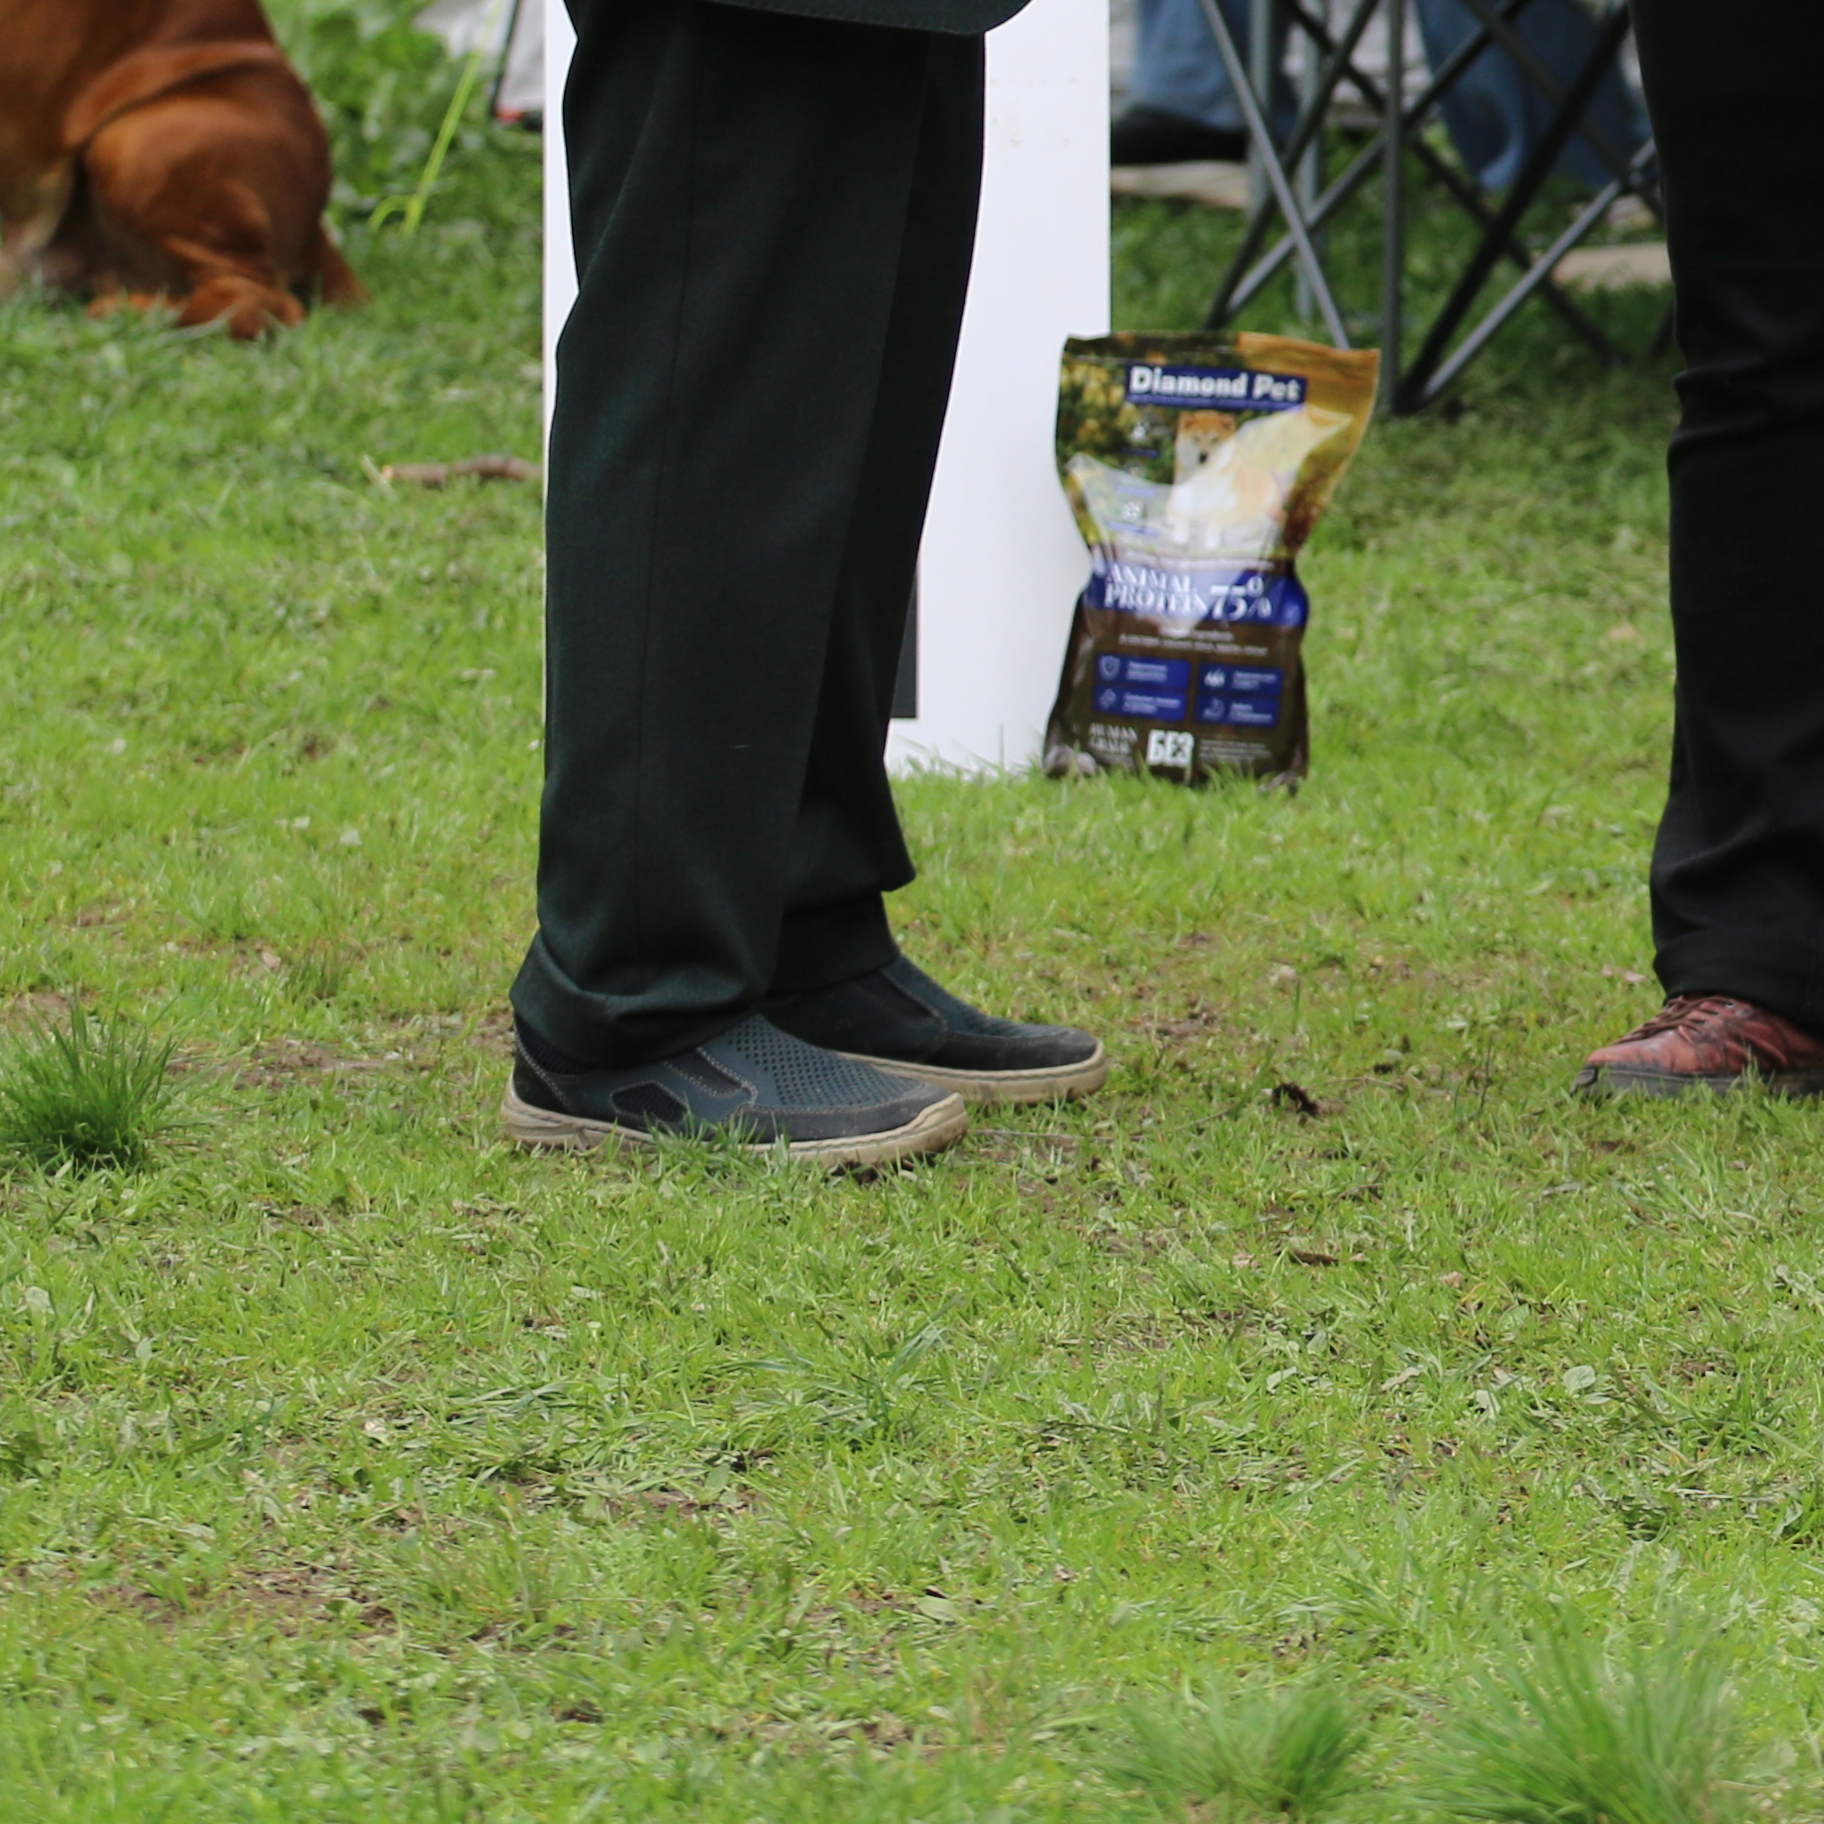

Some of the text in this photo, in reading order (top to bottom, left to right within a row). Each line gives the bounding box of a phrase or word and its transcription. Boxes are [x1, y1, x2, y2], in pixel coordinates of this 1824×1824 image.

[1129, 365, 1301, 402] Diamond Pet
[1107, 563, 1191, 592] ANIMAL
[1104, 583, 1209, 616] PROTEIN
[1208, 575, 1273, 621] 75%
[1145, 728, 1196, 768] БЕЗ
